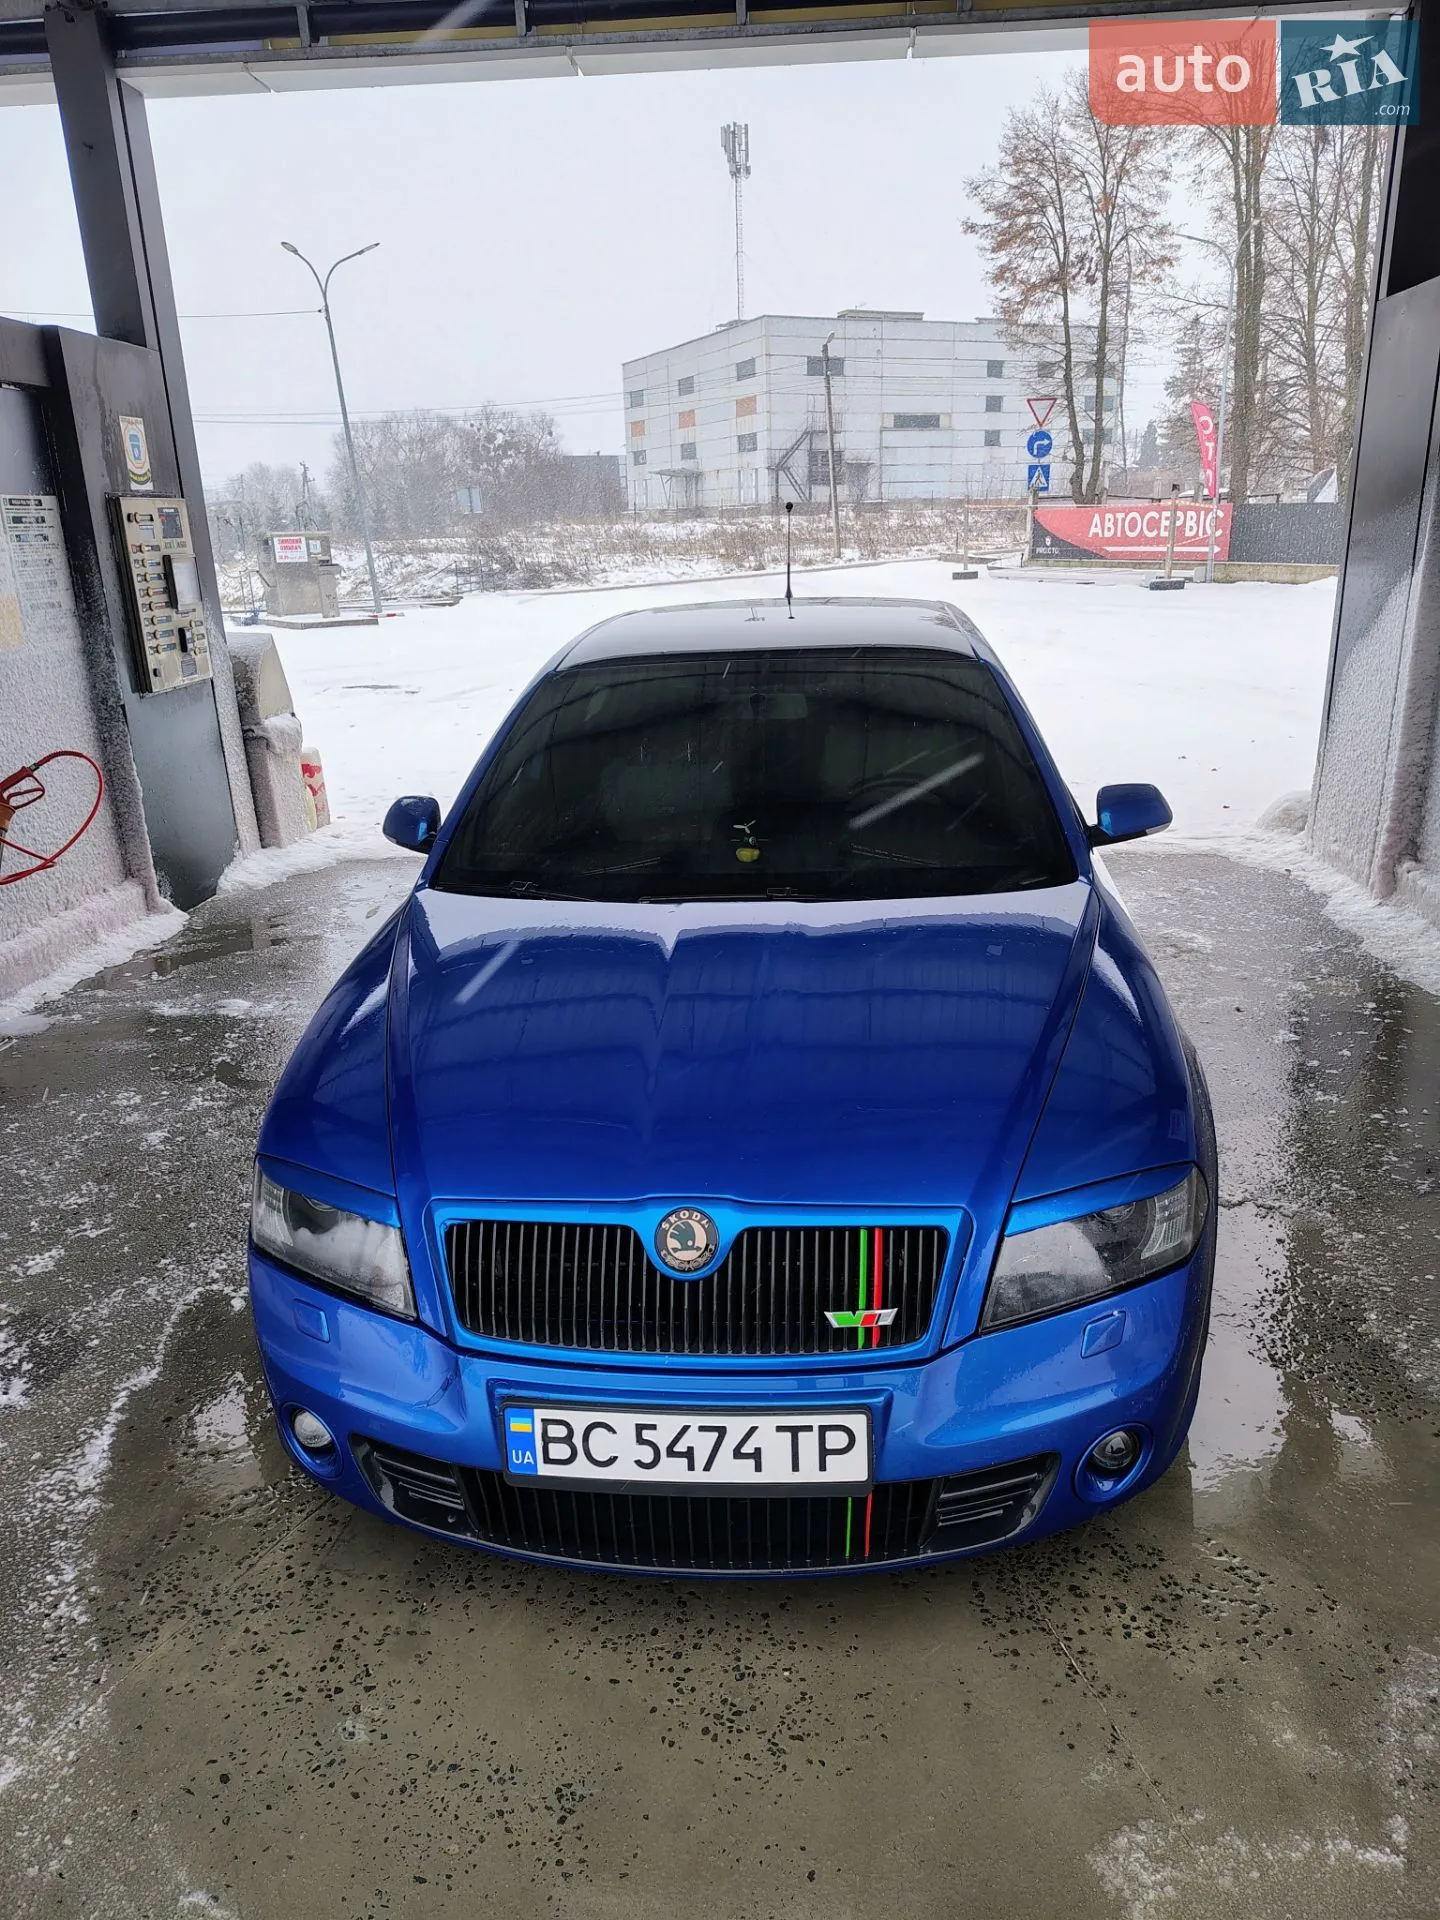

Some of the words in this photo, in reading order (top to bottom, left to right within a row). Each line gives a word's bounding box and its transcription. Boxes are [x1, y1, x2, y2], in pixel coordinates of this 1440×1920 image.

[1088, 509, 1224, 538] АВТОСЕРВІС
[512, 1450, 535, 1465] UA
[541, 1418, 619, 1468] BC
[633, 1423, 762, 1473] 5474
[775, 1424, 856, 1473] TP
